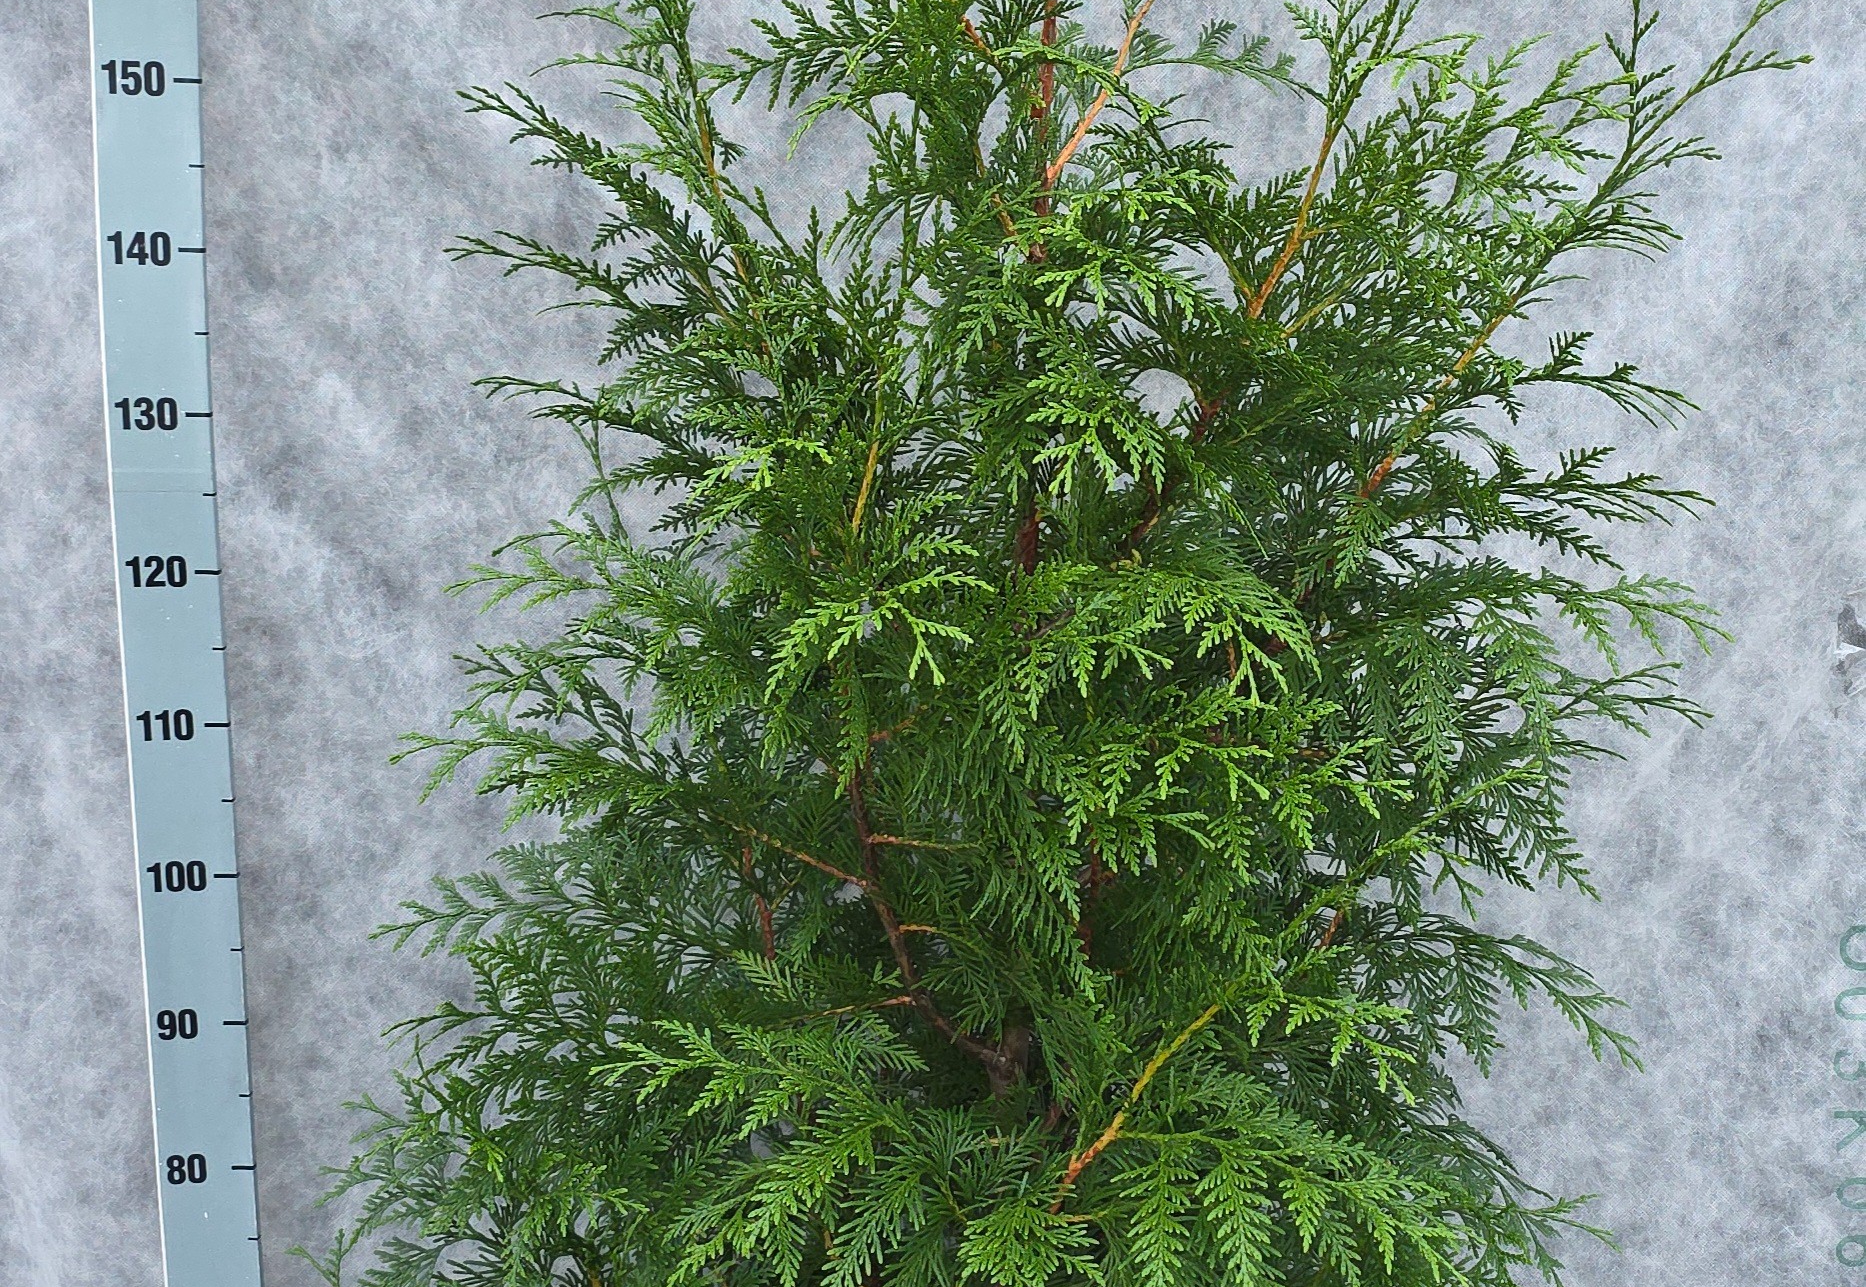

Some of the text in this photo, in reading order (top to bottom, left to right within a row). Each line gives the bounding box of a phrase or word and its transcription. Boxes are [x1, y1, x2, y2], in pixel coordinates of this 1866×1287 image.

[101, 59, 165, 97] 150
[107, 230, 171, 267] 140
[114, 396, 178, 431] 130
[125, 555, 187, 588] 120
[136, 708, 194, 742] 110
[146, 860, 207, 893] 100
[156, 1008, 199, 1041] 90
[166, 1153, 207, 1185] 80
